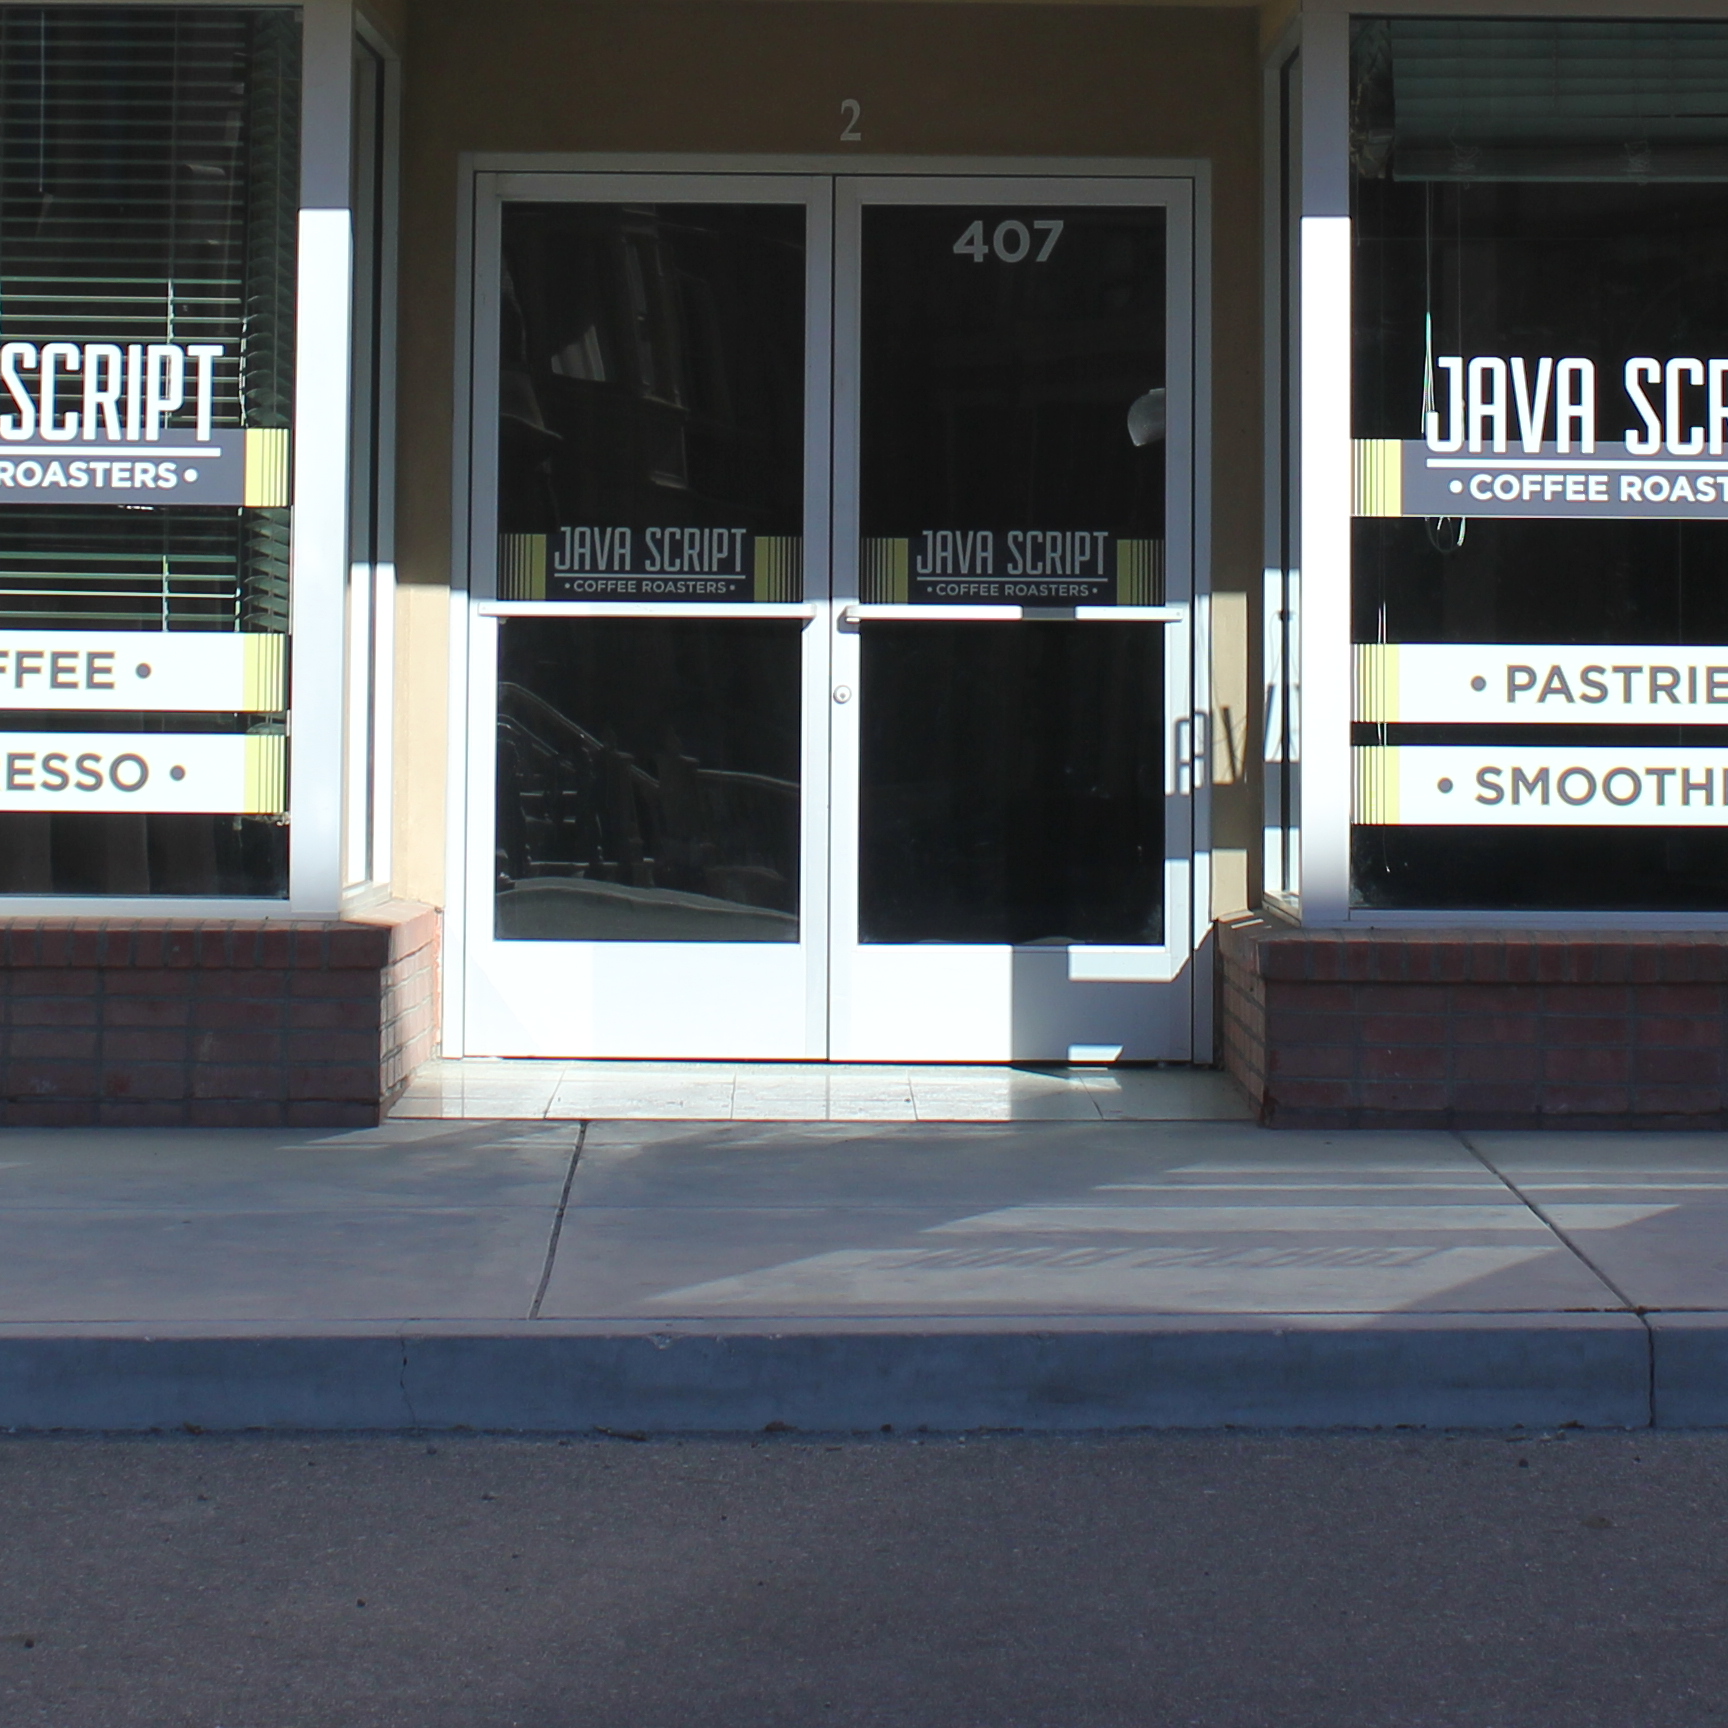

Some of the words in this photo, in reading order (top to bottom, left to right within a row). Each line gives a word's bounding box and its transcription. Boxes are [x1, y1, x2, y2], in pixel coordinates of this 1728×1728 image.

[839, 98, 862, 141] 2
[952, 219, 1064, 263] 407
[1425, 355, 1596, 454] JAVA
[1469, 473, 1609, 501] COFFEE
[554, 526, 631, 571] JAVA
[644, 527, 747, 572] SCRIPT
[916, 530, 994, 574] JAVA
[1007, 531, 1109, 575] SCRIPT
[573, 579, 637, 593] COFFEE
[642, 580, 727, 594] ROASTERS
[936, 583, 1000, 597] COFFEE
[1004, 584, 1089, 597] ROASTERS
